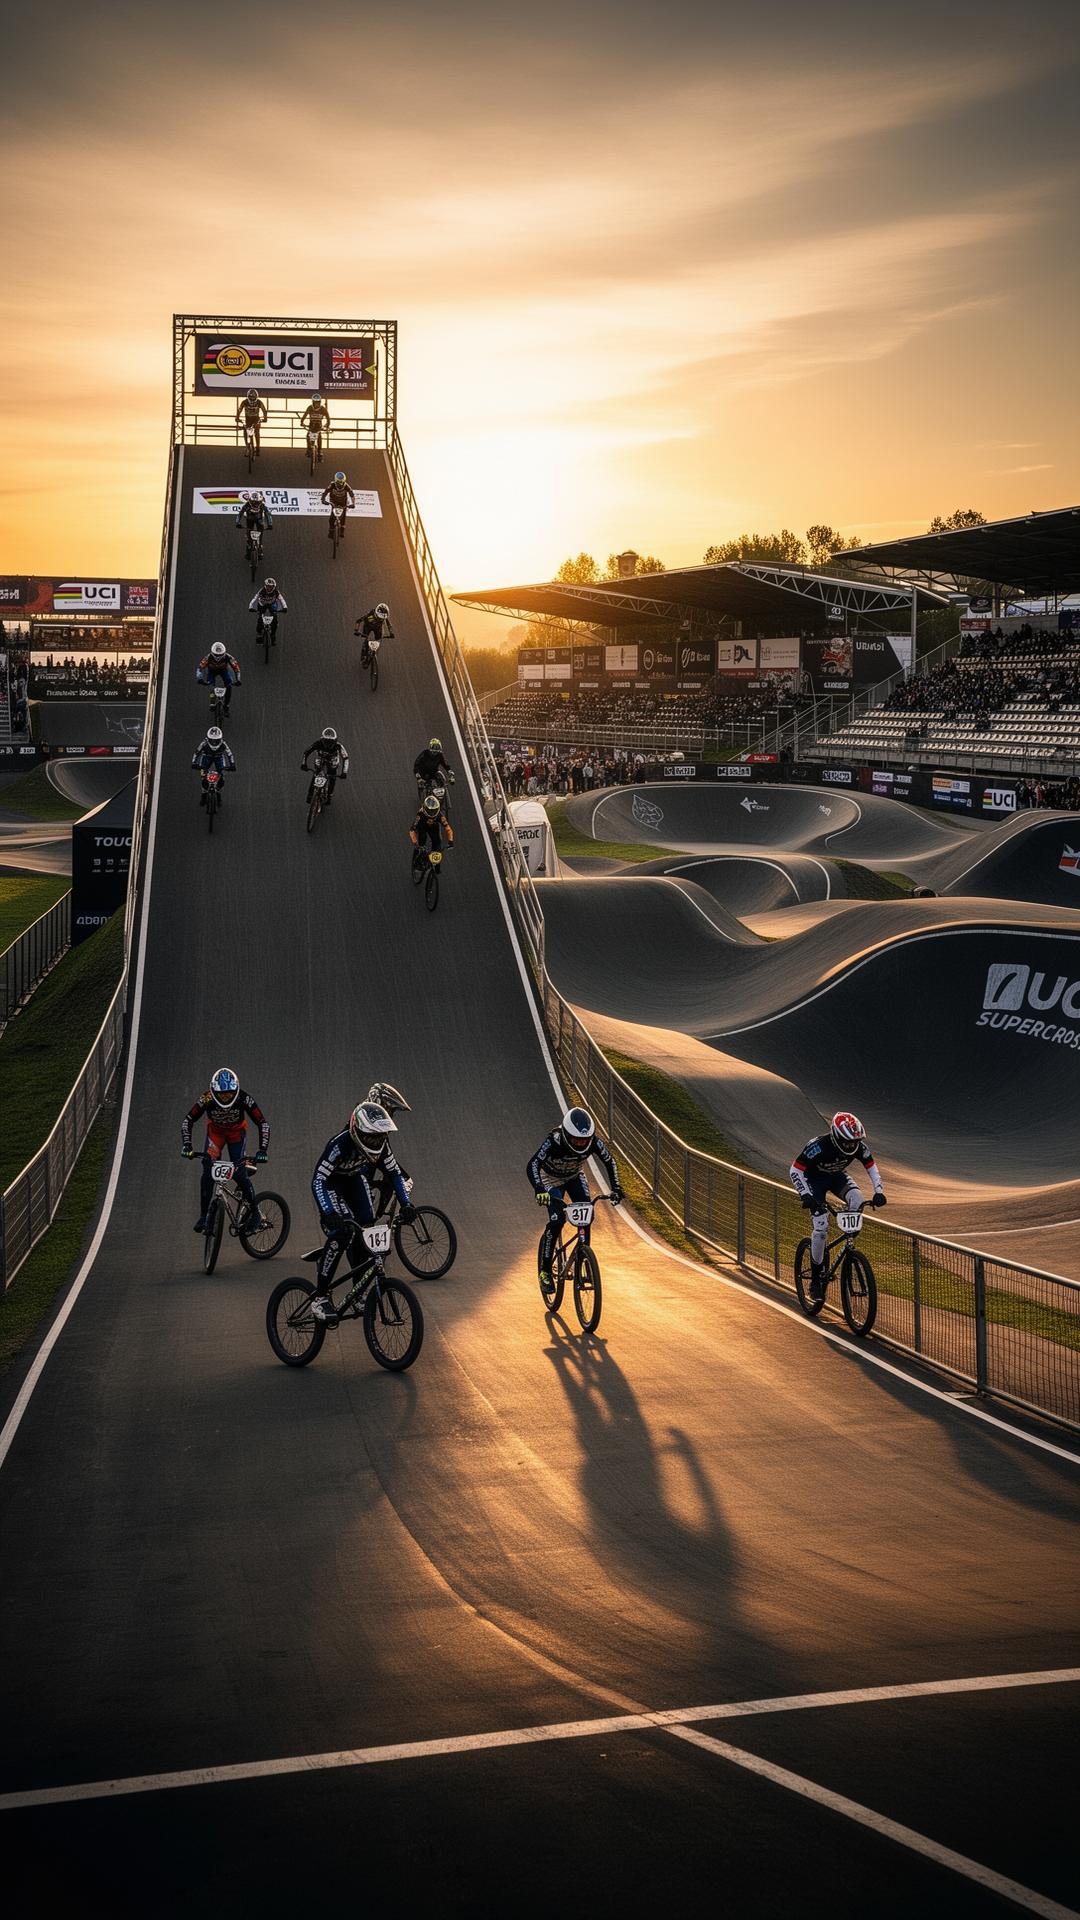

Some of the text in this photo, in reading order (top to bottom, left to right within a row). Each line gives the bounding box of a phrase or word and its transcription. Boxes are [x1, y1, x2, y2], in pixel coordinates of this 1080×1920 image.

[268, 351, 314, 371] UCI
[84, 586, 116, 599] UCI
[993, 792, 1014, 808] UCI
[976, 1012, 1080, 1050] SUPERCROS
